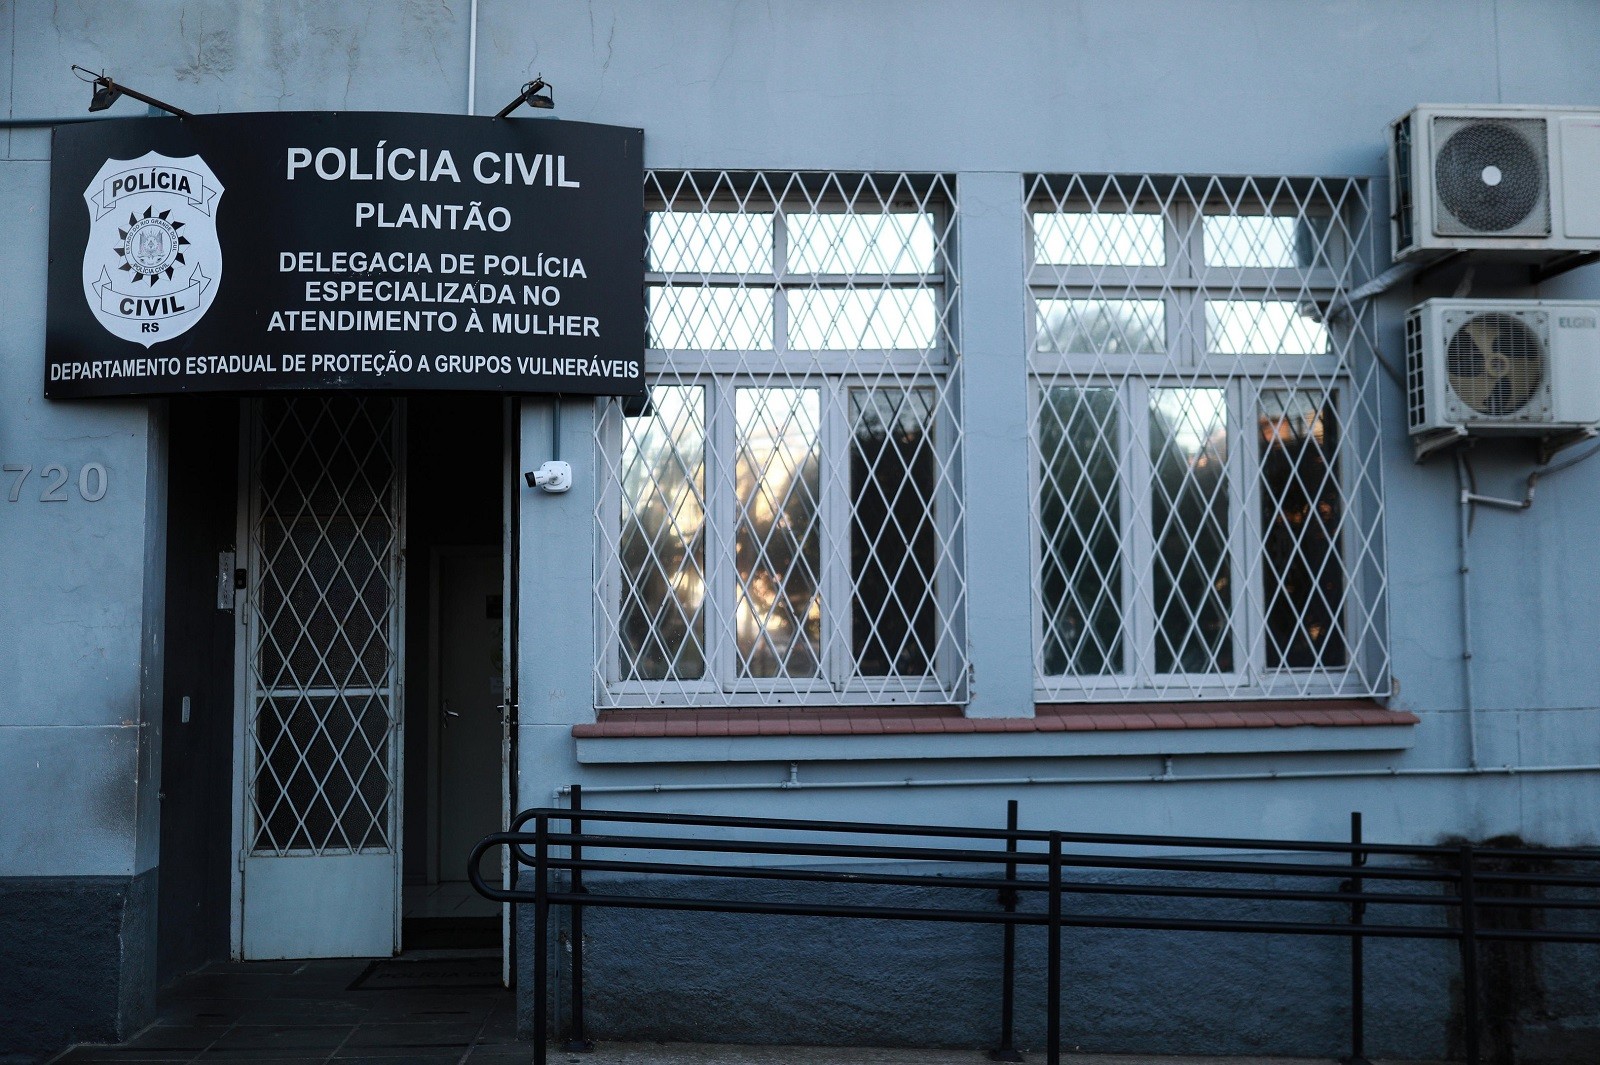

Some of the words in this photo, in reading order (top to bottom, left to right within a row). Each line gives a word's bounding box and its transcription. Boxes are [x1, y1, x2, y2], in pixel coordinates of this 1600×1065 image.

[287, 140, 461, 182] POLÍCIA
[473, 152, 580, 188] CIVIL
[113, 168, 191, 197] POLÍCIA
[356, 201, 511, 232] PLANTÃO
[280, 252, 432, 273] DELEGACIA
[441, 254, 474, 274] DE
[485, 253, 587, 278] POLÍCIA
[120, 296, 184, 316] CIVIL
[306, 281, 516, 304] ESPECIALIZADA
[524, 285, 560, 306] NO
[142, 323, 159, 332] RS
[267, 311, 457, 332] ATENDIMENTO
[465, 308, 484, 332] À
[493, 313, 600, 337] MULHER
[51, 358, 180, 380] DEPARTAMENTO
[186, 355, 276, 374] ESTADUAL
[283, 355, 305, 371] DE
[312, 350, 412, 376] PROTEÇÃO
[417, 355, 430, 372] A
[435, 355, 511, 373] GRUPOS
[517, 355, 639, 378] VULNERÁVEIS
[3, 463, 108, 502] 720
